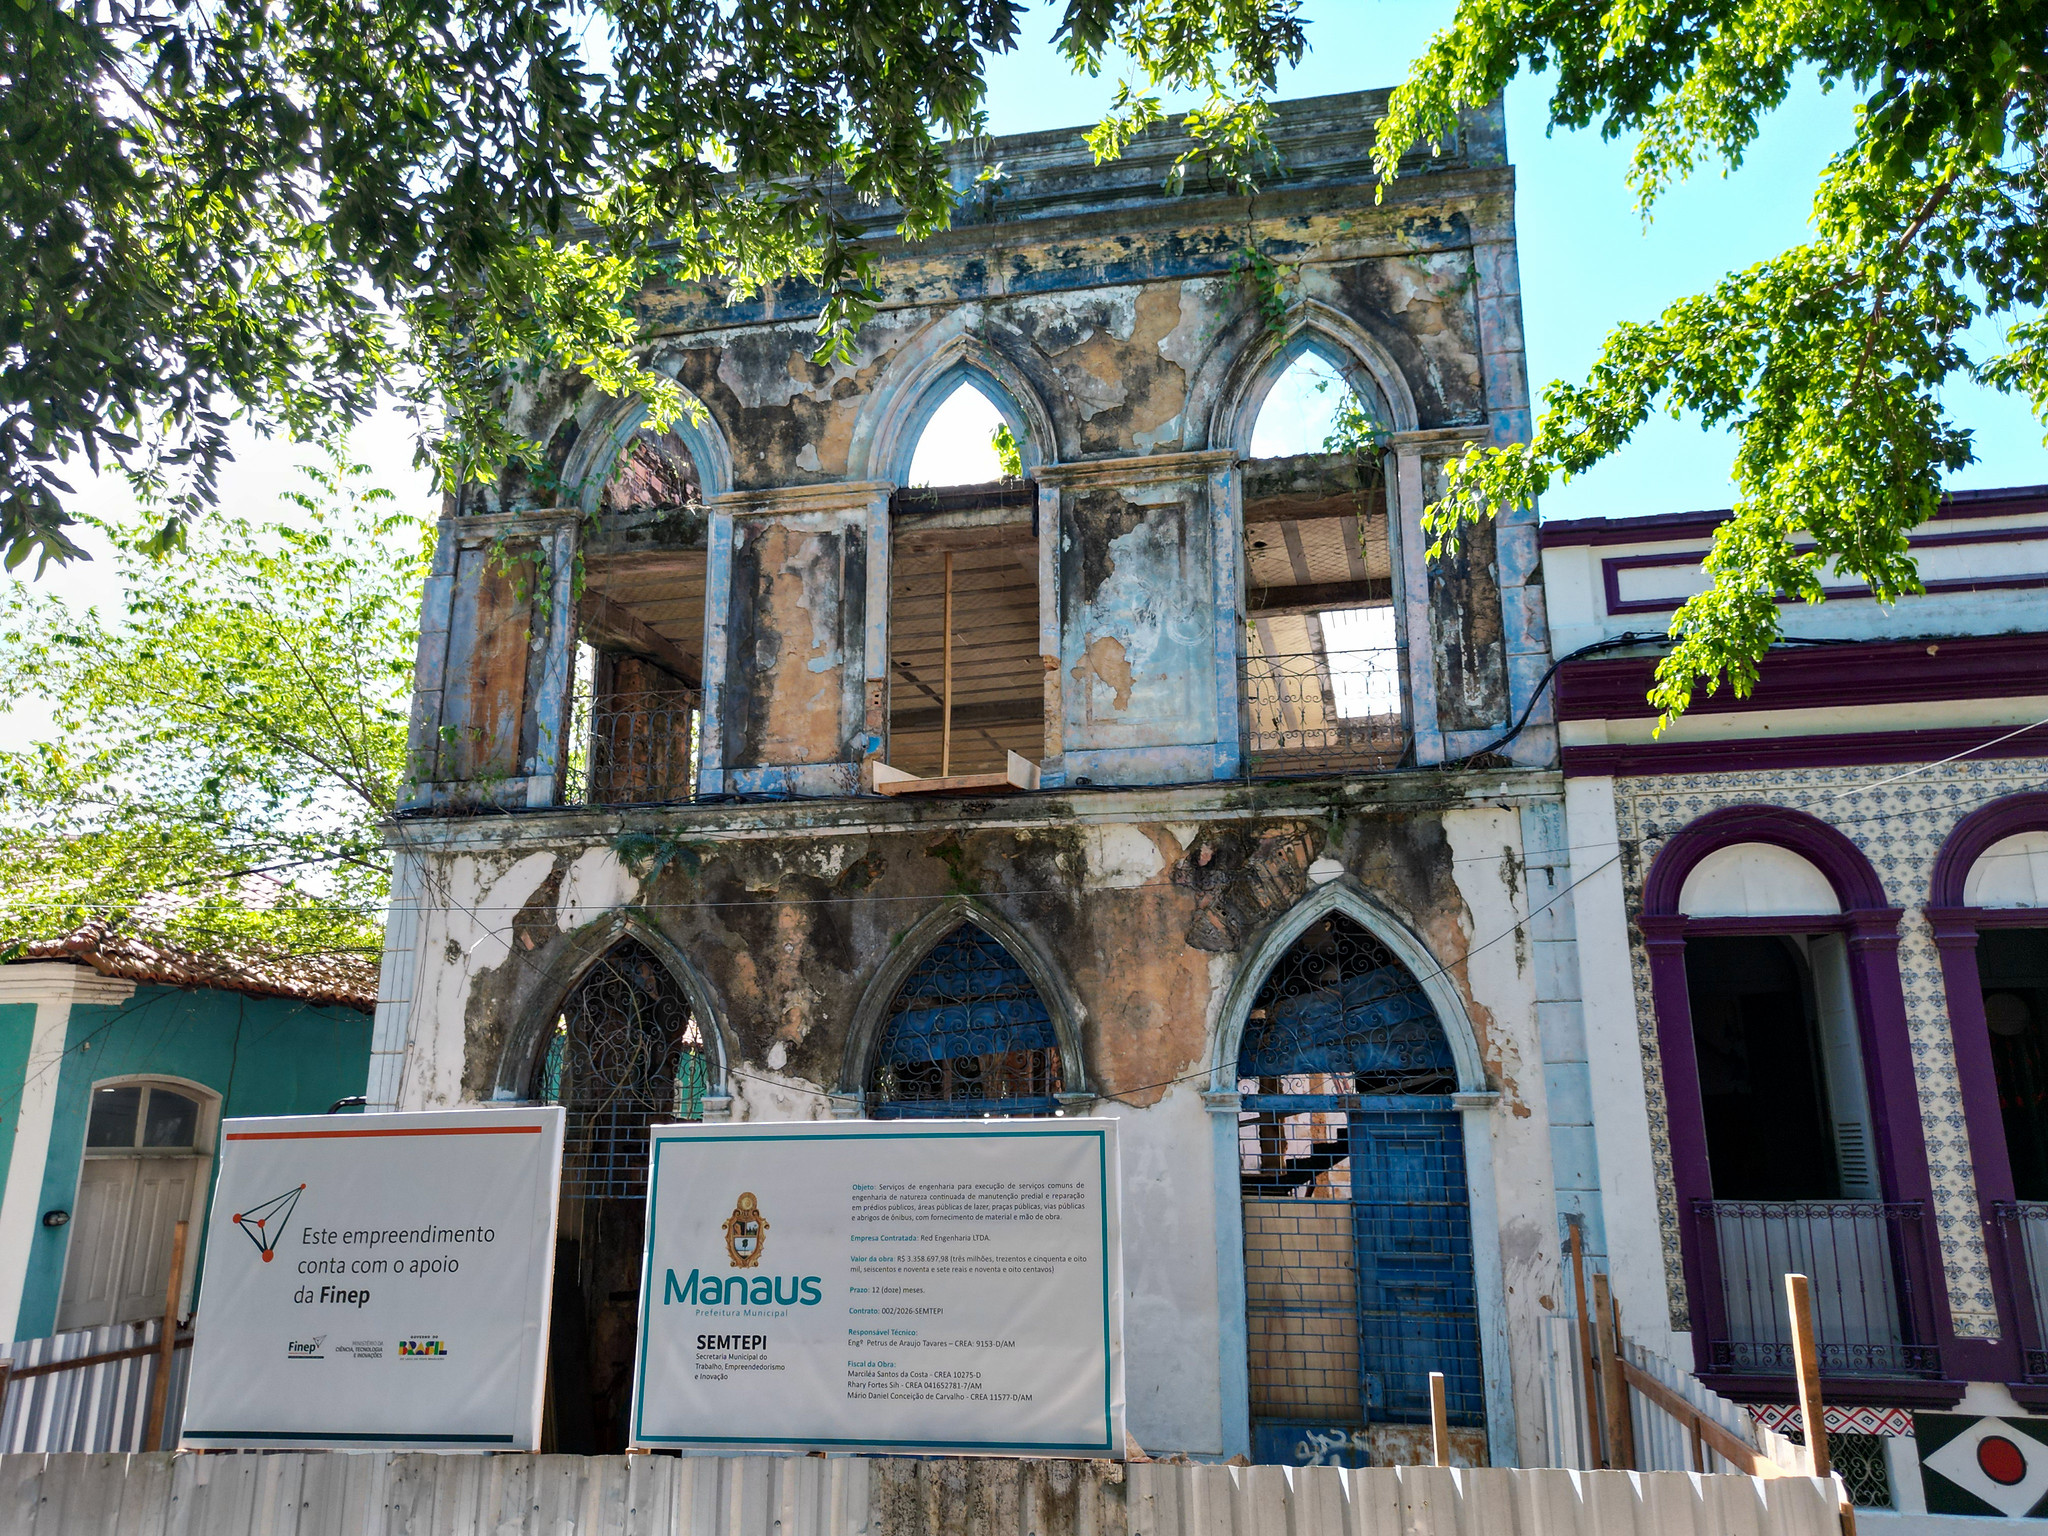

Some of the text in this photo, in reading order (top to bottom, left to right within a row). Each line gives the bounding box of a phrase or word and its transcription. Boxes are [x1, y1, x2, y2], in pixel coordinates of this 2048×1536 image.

[852, 1184, 876, 1192] Objeto:
[919, 1183, 955, 1192] engenharia
[975, 1183, 1005, 1191] execução
[978, 1193, 1019, 1201] manutenção
[1052, 1192, 1085, 1201] reparação
[1014, 1203, 1042, 1211] públicas,
[857, 1214, 880, 1223] abrigos
[302, 1225, 495, 1248] Este empreendimento
[850, 1235, 879, 1243] Empresa
[935, 1235, 971, 1243] Engenharia
[298, 1256, 459, 1278] conta com o apoio
[1022, 1266, 1055, 1274] centavos)
[664, 1268, 823, 1306] Manaus
[882, 1286, 902, 1295] (doze)
[294, 1285, 370, 1309] da Finep
[696, 1308, 788, 1318] Prefeitura Municipal
[288, 1340, 316, 1354] Finep
[697, 1335, 767, 1350] SEMTEPI
[899, 1340, 921, 1348] Araujo
[976, 1340, 1016, 1348] 9153-D/AM
[398, 1341, 448, 1355] BRASIL
[724, 1363, 786, 1371] Empreendedorismo
[848, 1381, 866, 1389] Rhary
[890, 1393, 924, 1401] Conceição
[990, 1394, 1033, 1402] 11577-D/AM
